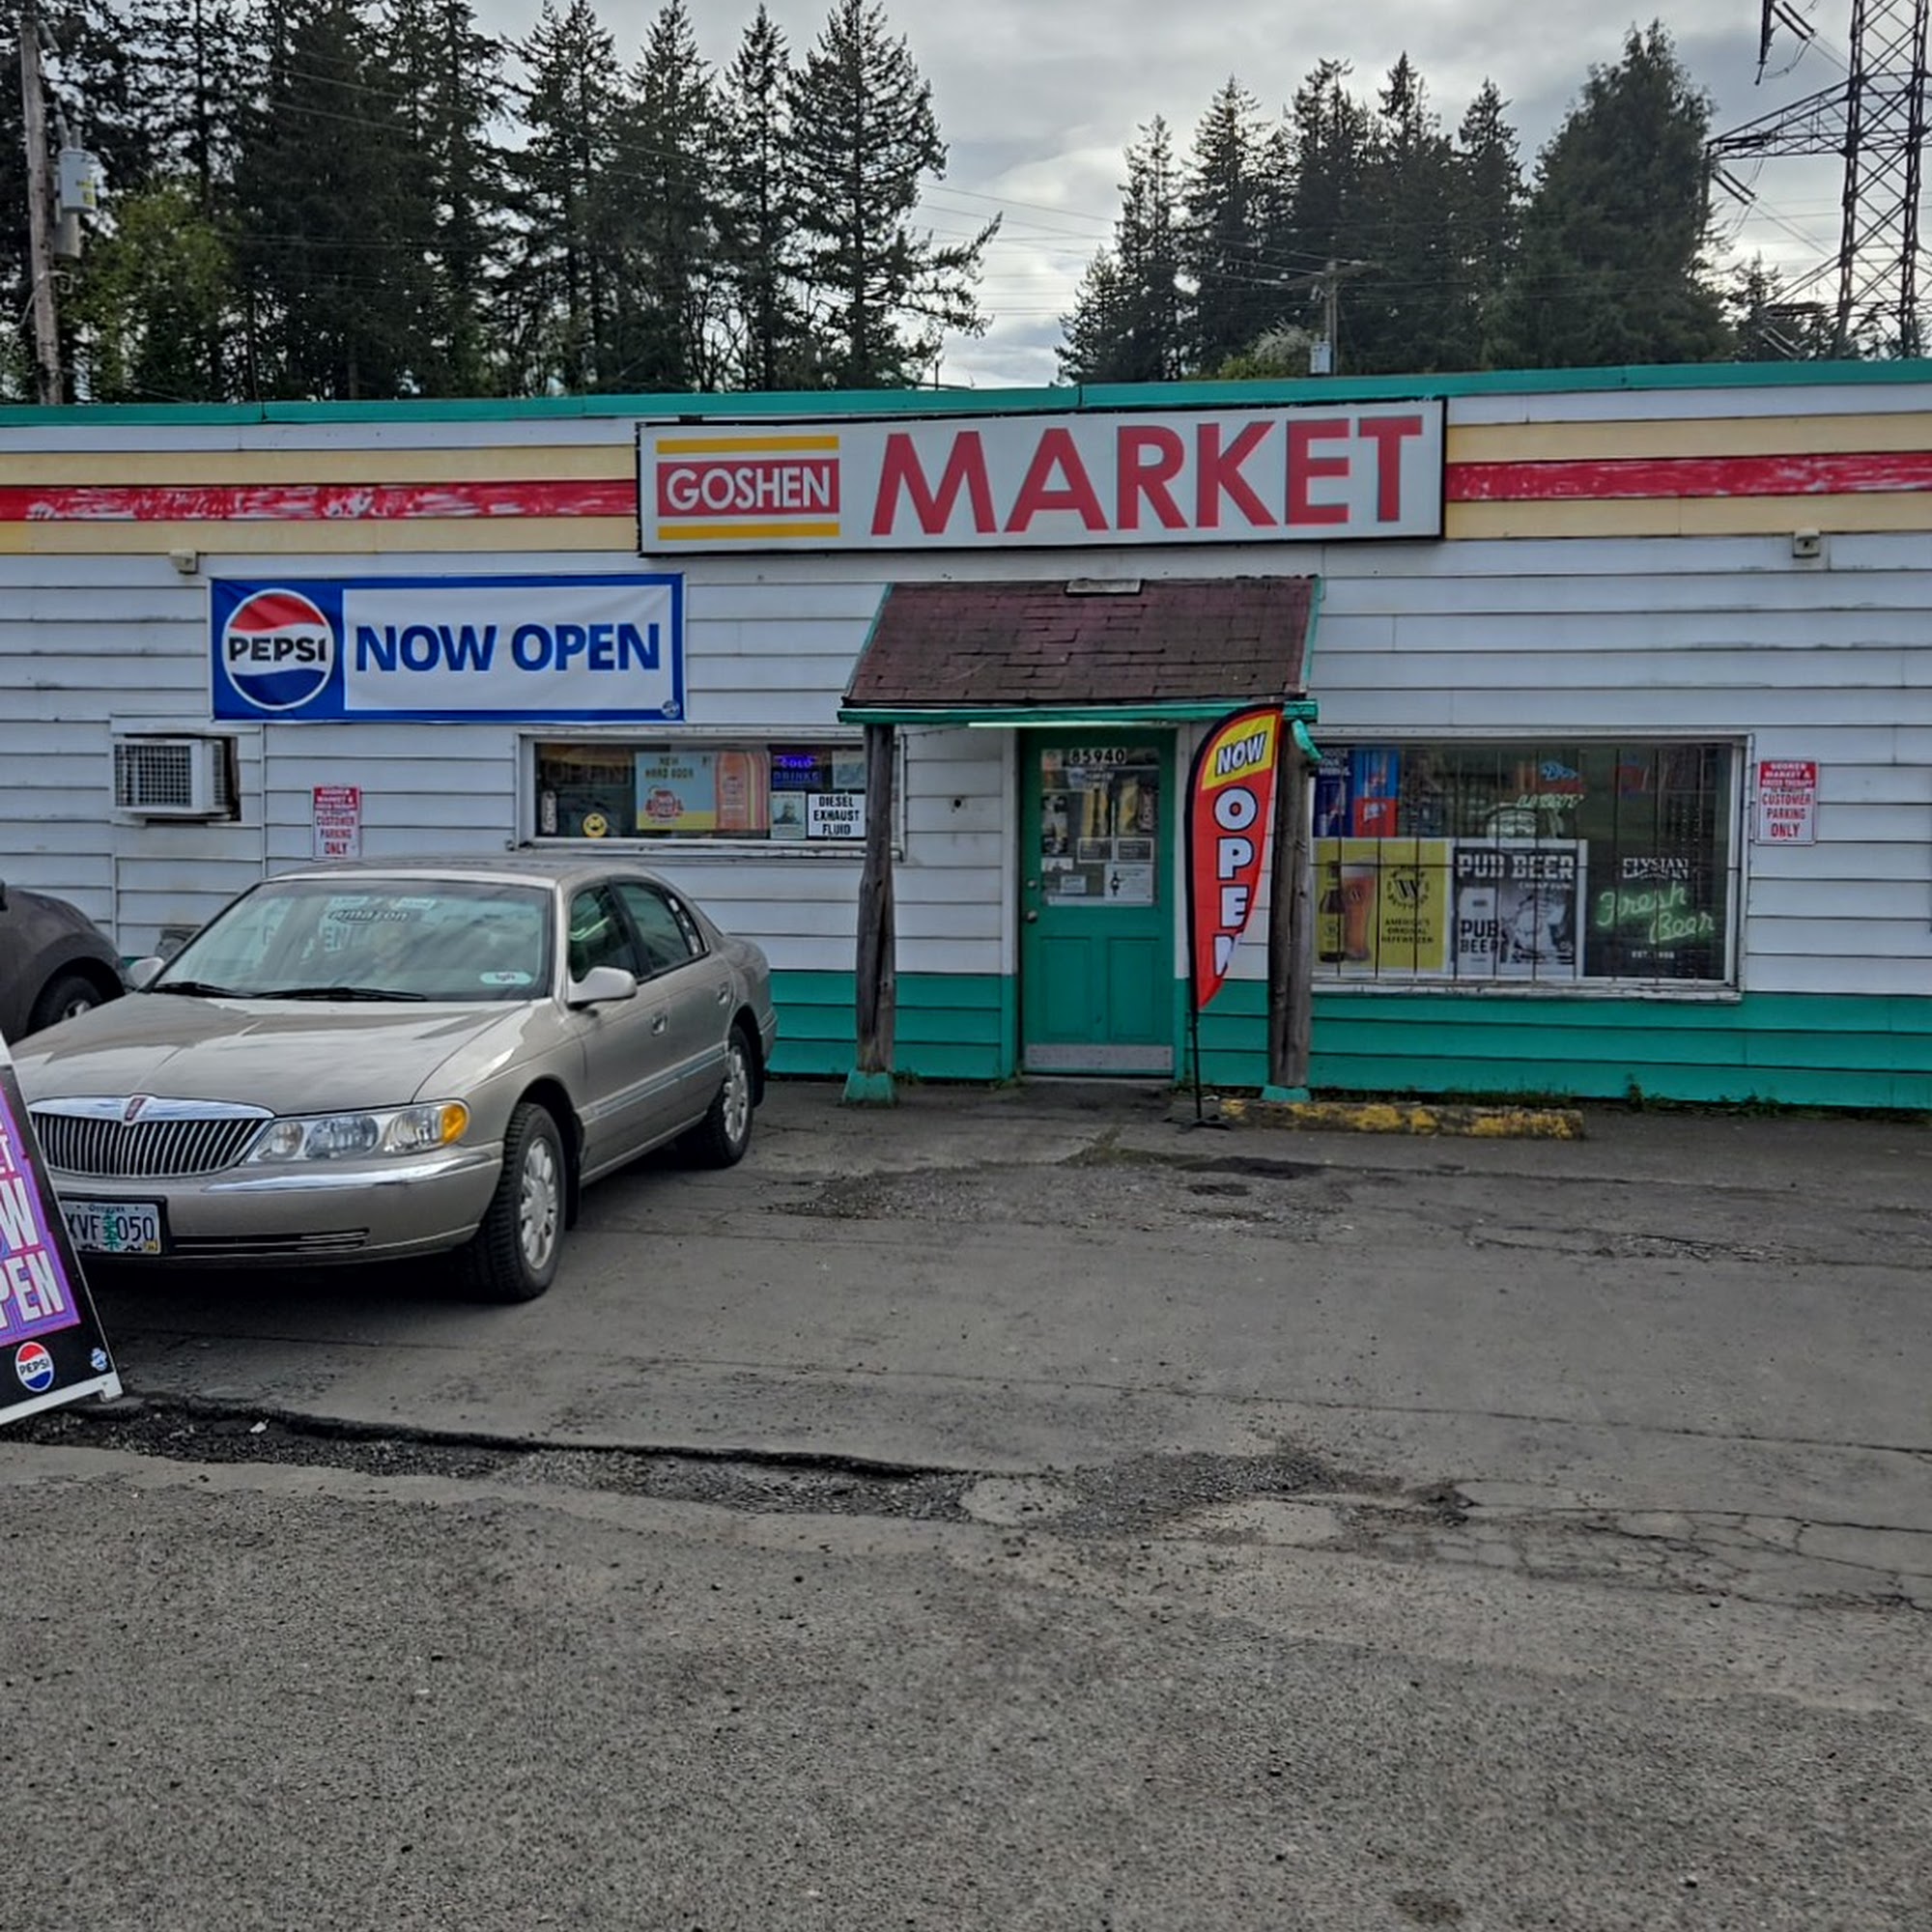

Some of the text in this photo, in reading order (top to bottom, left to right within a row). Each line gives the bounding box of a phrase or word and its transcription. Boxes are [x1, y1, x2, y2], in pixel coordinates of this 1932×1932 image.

[666, 415, 1423, 535] GOSHEN MARKET
[228, 637, 327, 663] PEPSI
[355, 622, 660, 672] NOW OPEN
[1071, 749, 1125, 763] 85940
[1215, 730, 1266, 777] NOW
[780, 756, 813, 769] COLD
[773, 771, 820, 782] DRINKS
[818, 795, 854, 808] DIESEL
[1762, 793, 1812, 806] CUSTOMER
[316, 816, 355, 826] CUSTOMER
[813, 810, 860, 822] EXHAUST
[1766, 807, 1805, 820] PARKING
[320, 829, 352, 839] PARKING
[822, 823, 851, 836] FLUID
[1771, 822, 1801, 838] ONLY
[325, 841, 347, 855] ONLY
[1457, 854, 1505, 879] PUB
[1511, 855, 1575, 880] BEER
[1623, 856, 1689, 879] ELYSIAN
[1596, 880, 1687, 927] Fresh
[1460, 919, 1498, 938] PUB
[1648, 911, 1716, 945] Beer
[65, 1213, 155, 1242] XVF 050
[0, 1248, 66, 1329] PEN
[18, 1357, 50, 1376] PEPSI
